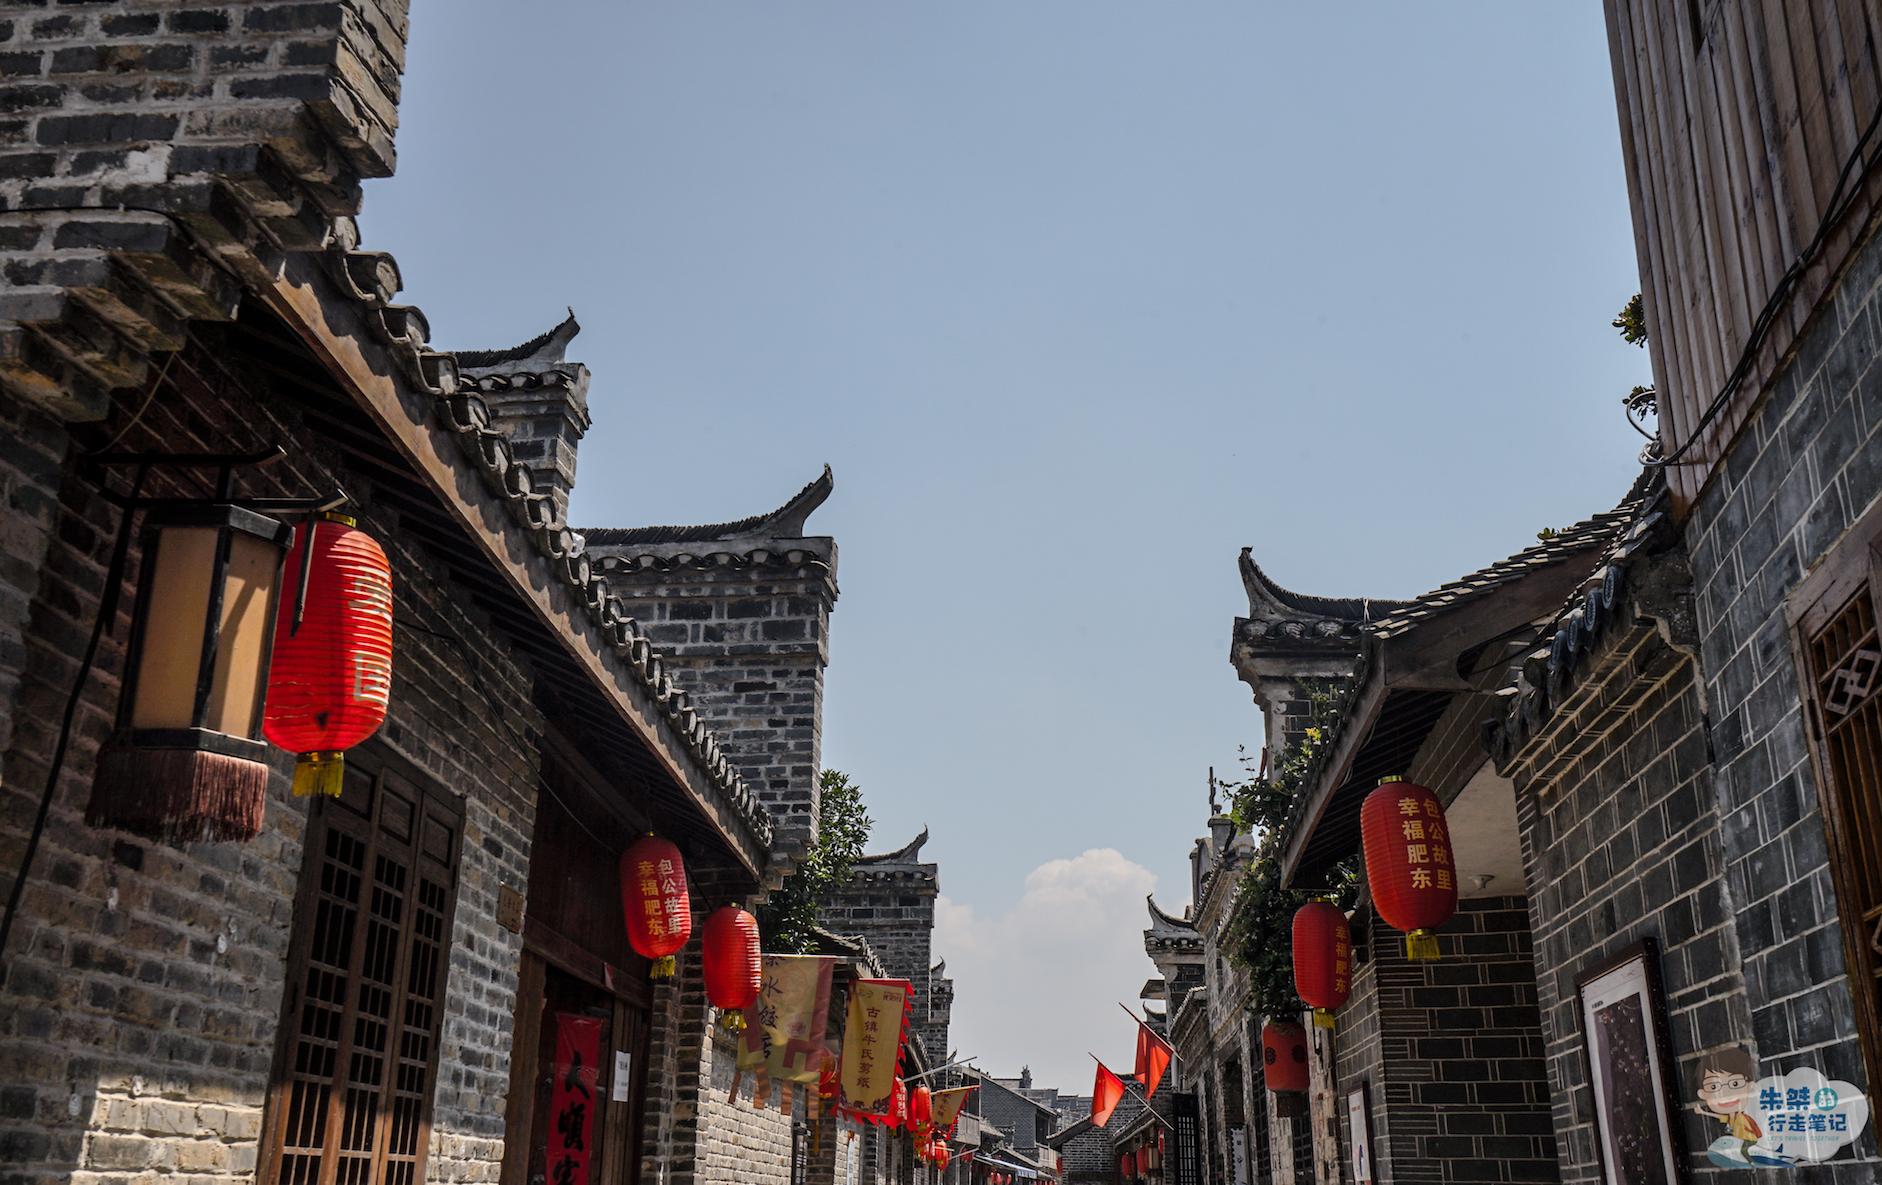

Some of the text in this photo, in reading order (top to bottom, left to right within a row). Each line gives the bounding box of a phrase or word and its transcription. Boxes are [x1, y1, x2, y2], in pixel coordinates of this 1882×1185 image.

[1398, 798, 1432, 889] 幸福肥东
[1423, 799, 1453, 890] 包公故里
[638, 861, 662, 935] 幸福肥东
[658, 859, 682, 935] 包公故里
